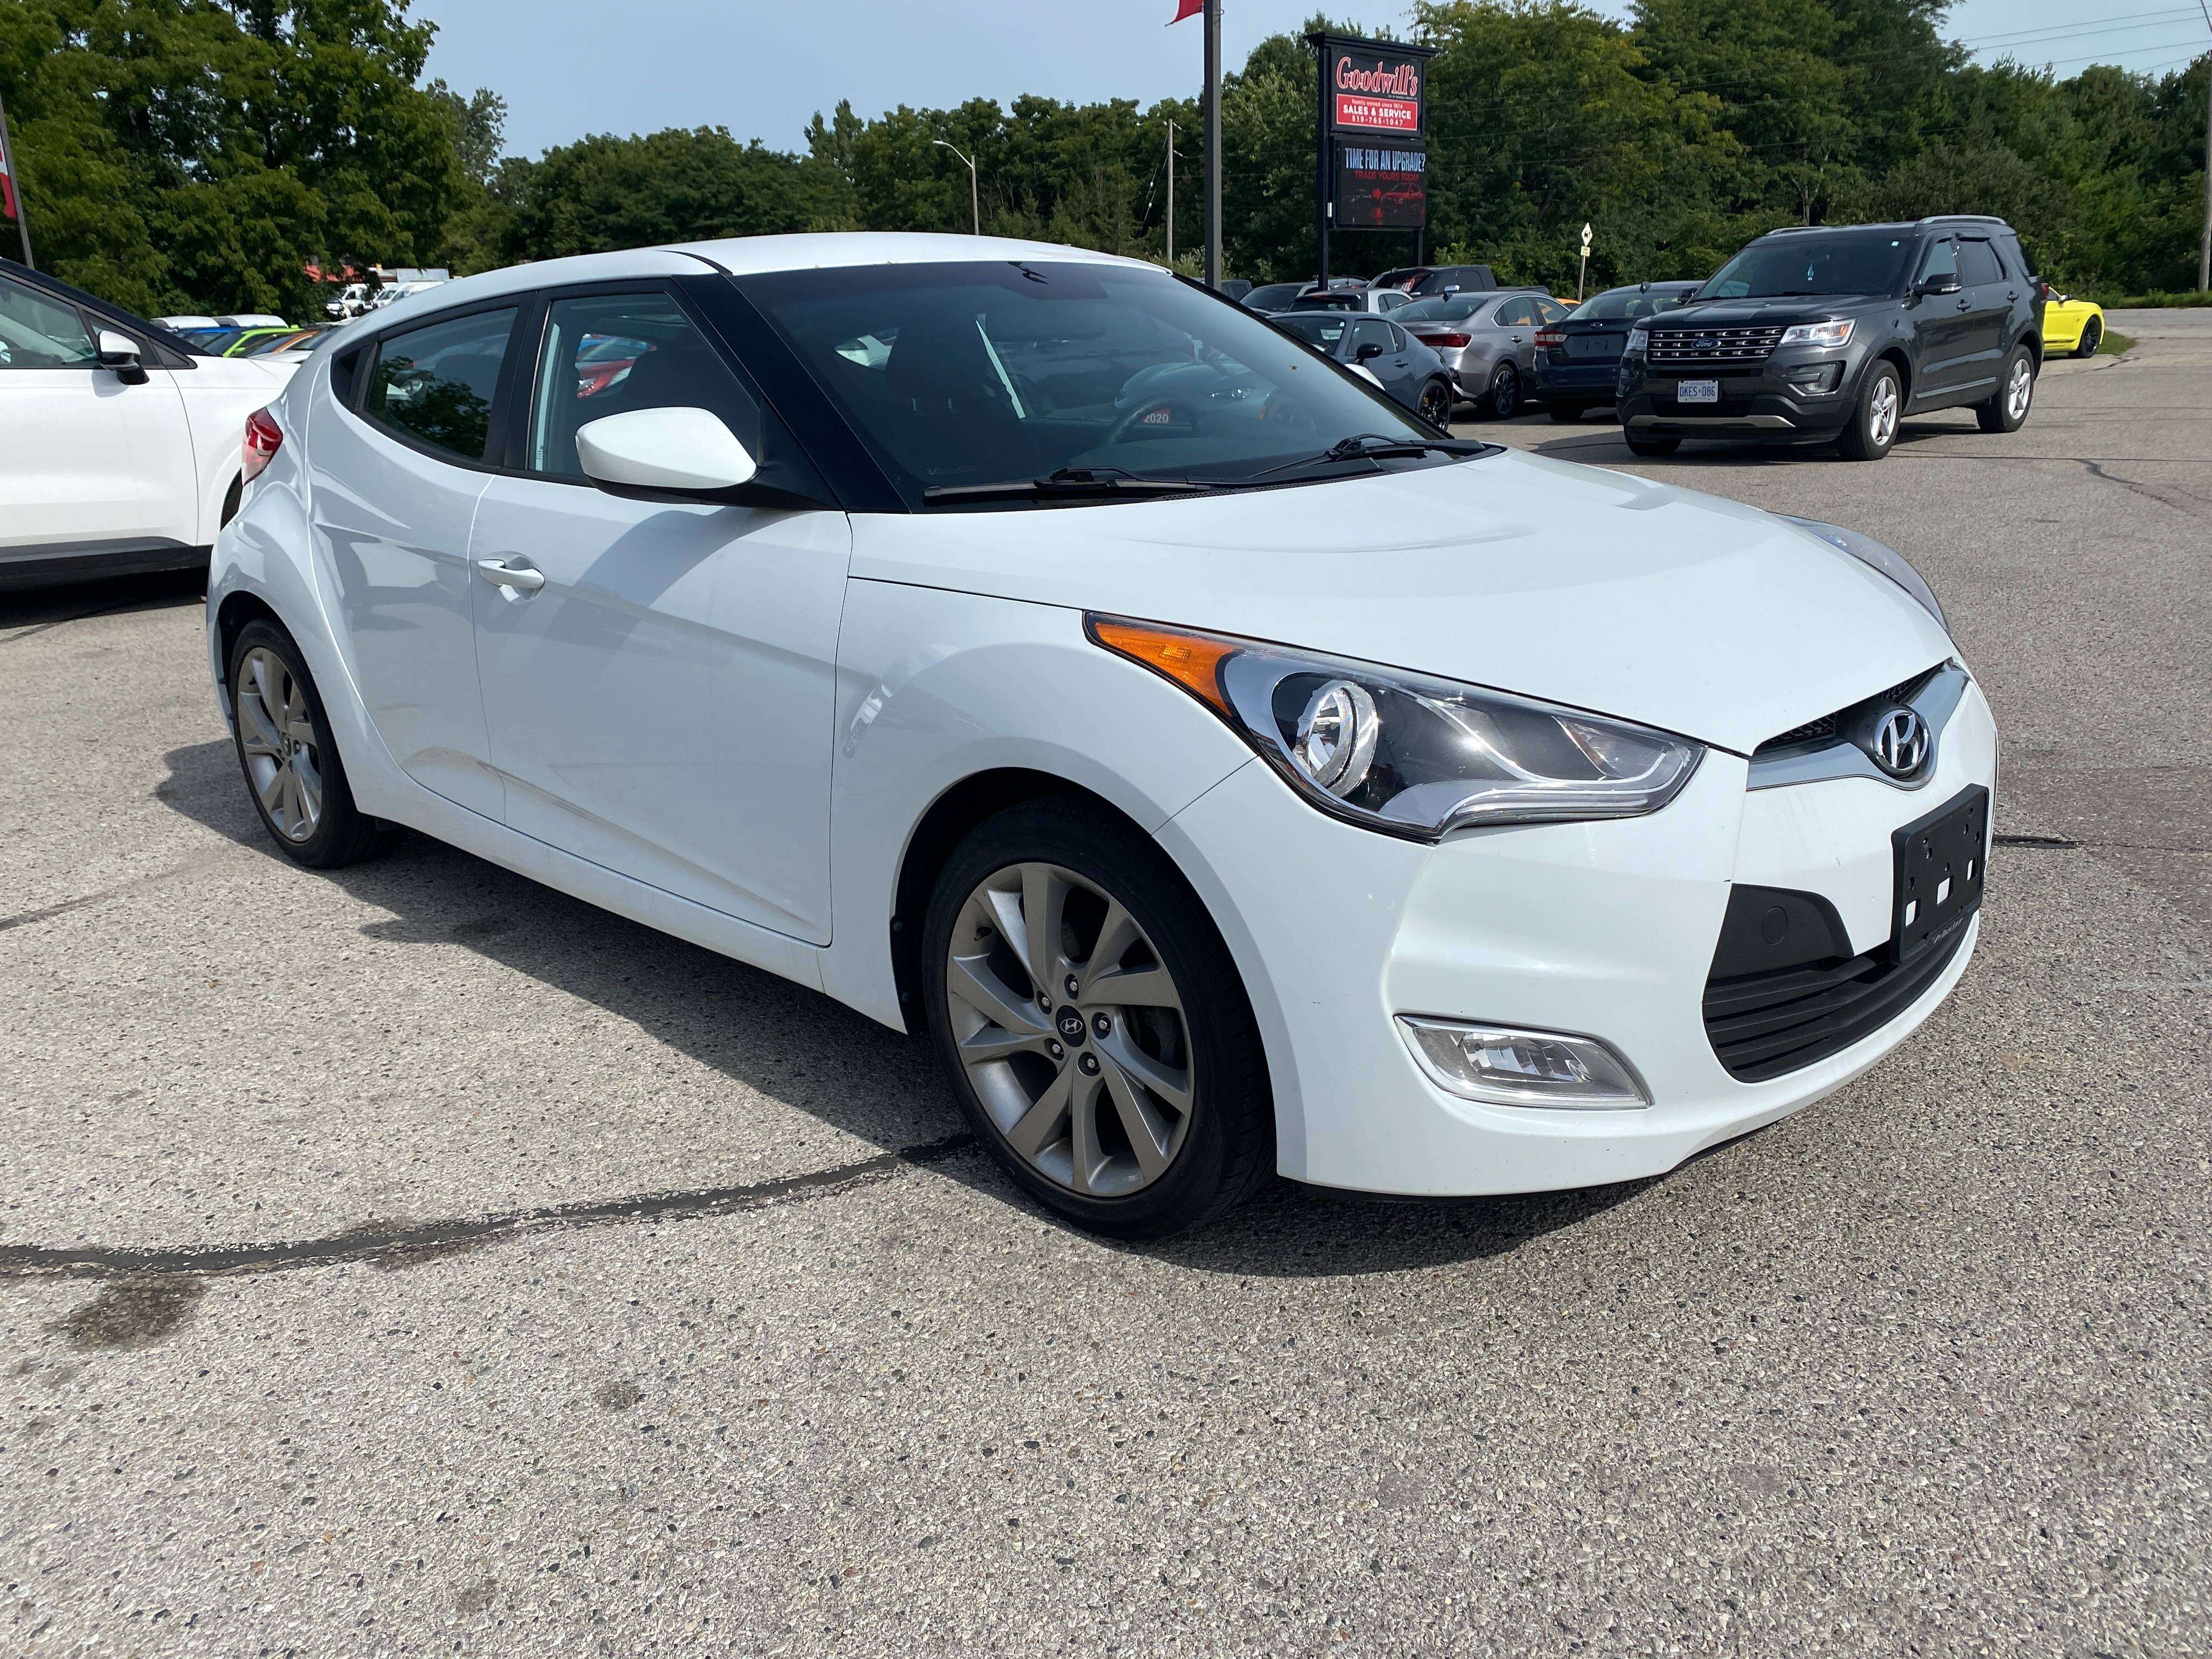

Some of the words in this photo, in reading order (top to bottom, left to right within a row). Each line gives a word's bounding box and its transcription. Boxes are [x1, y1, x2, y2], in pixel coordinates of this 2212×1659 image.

[1336, 57, 1418, 96] Goodwill's
[1343, 104, 1369, 115] SALES
[1371, 107, 1376, 116] &
[1379, 108, 1412, 120] SERVICE
[1345, 147, 1364, 169] TIME
[1365, 149, 1379, 170] FOR
[1380, 150, 1391, 171] AN
[1392, 150, 1426, 172] UPGRADE?
[1144, 413, 1169, 424] 2020
